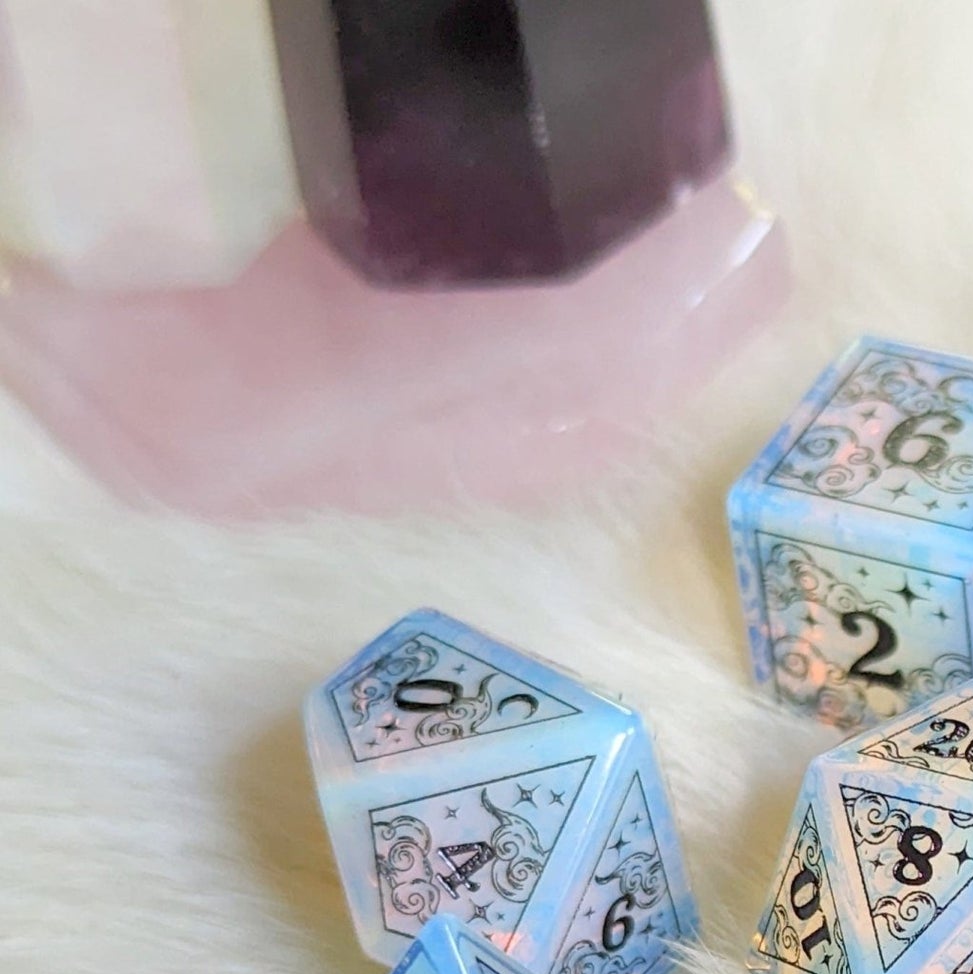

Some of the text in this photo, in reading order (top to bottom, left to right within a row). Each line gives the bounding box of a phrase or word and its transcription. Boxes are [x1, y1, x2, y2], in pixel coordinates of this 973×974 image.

[882, 410, 963, 468] 6
[841, 611, 903, 688] 2
[436, 840, 497, 900] 4
[893, 825, 943, 886] 8
[602, 894, 636, 952] 6
[789, 870, 831, 962] 10
